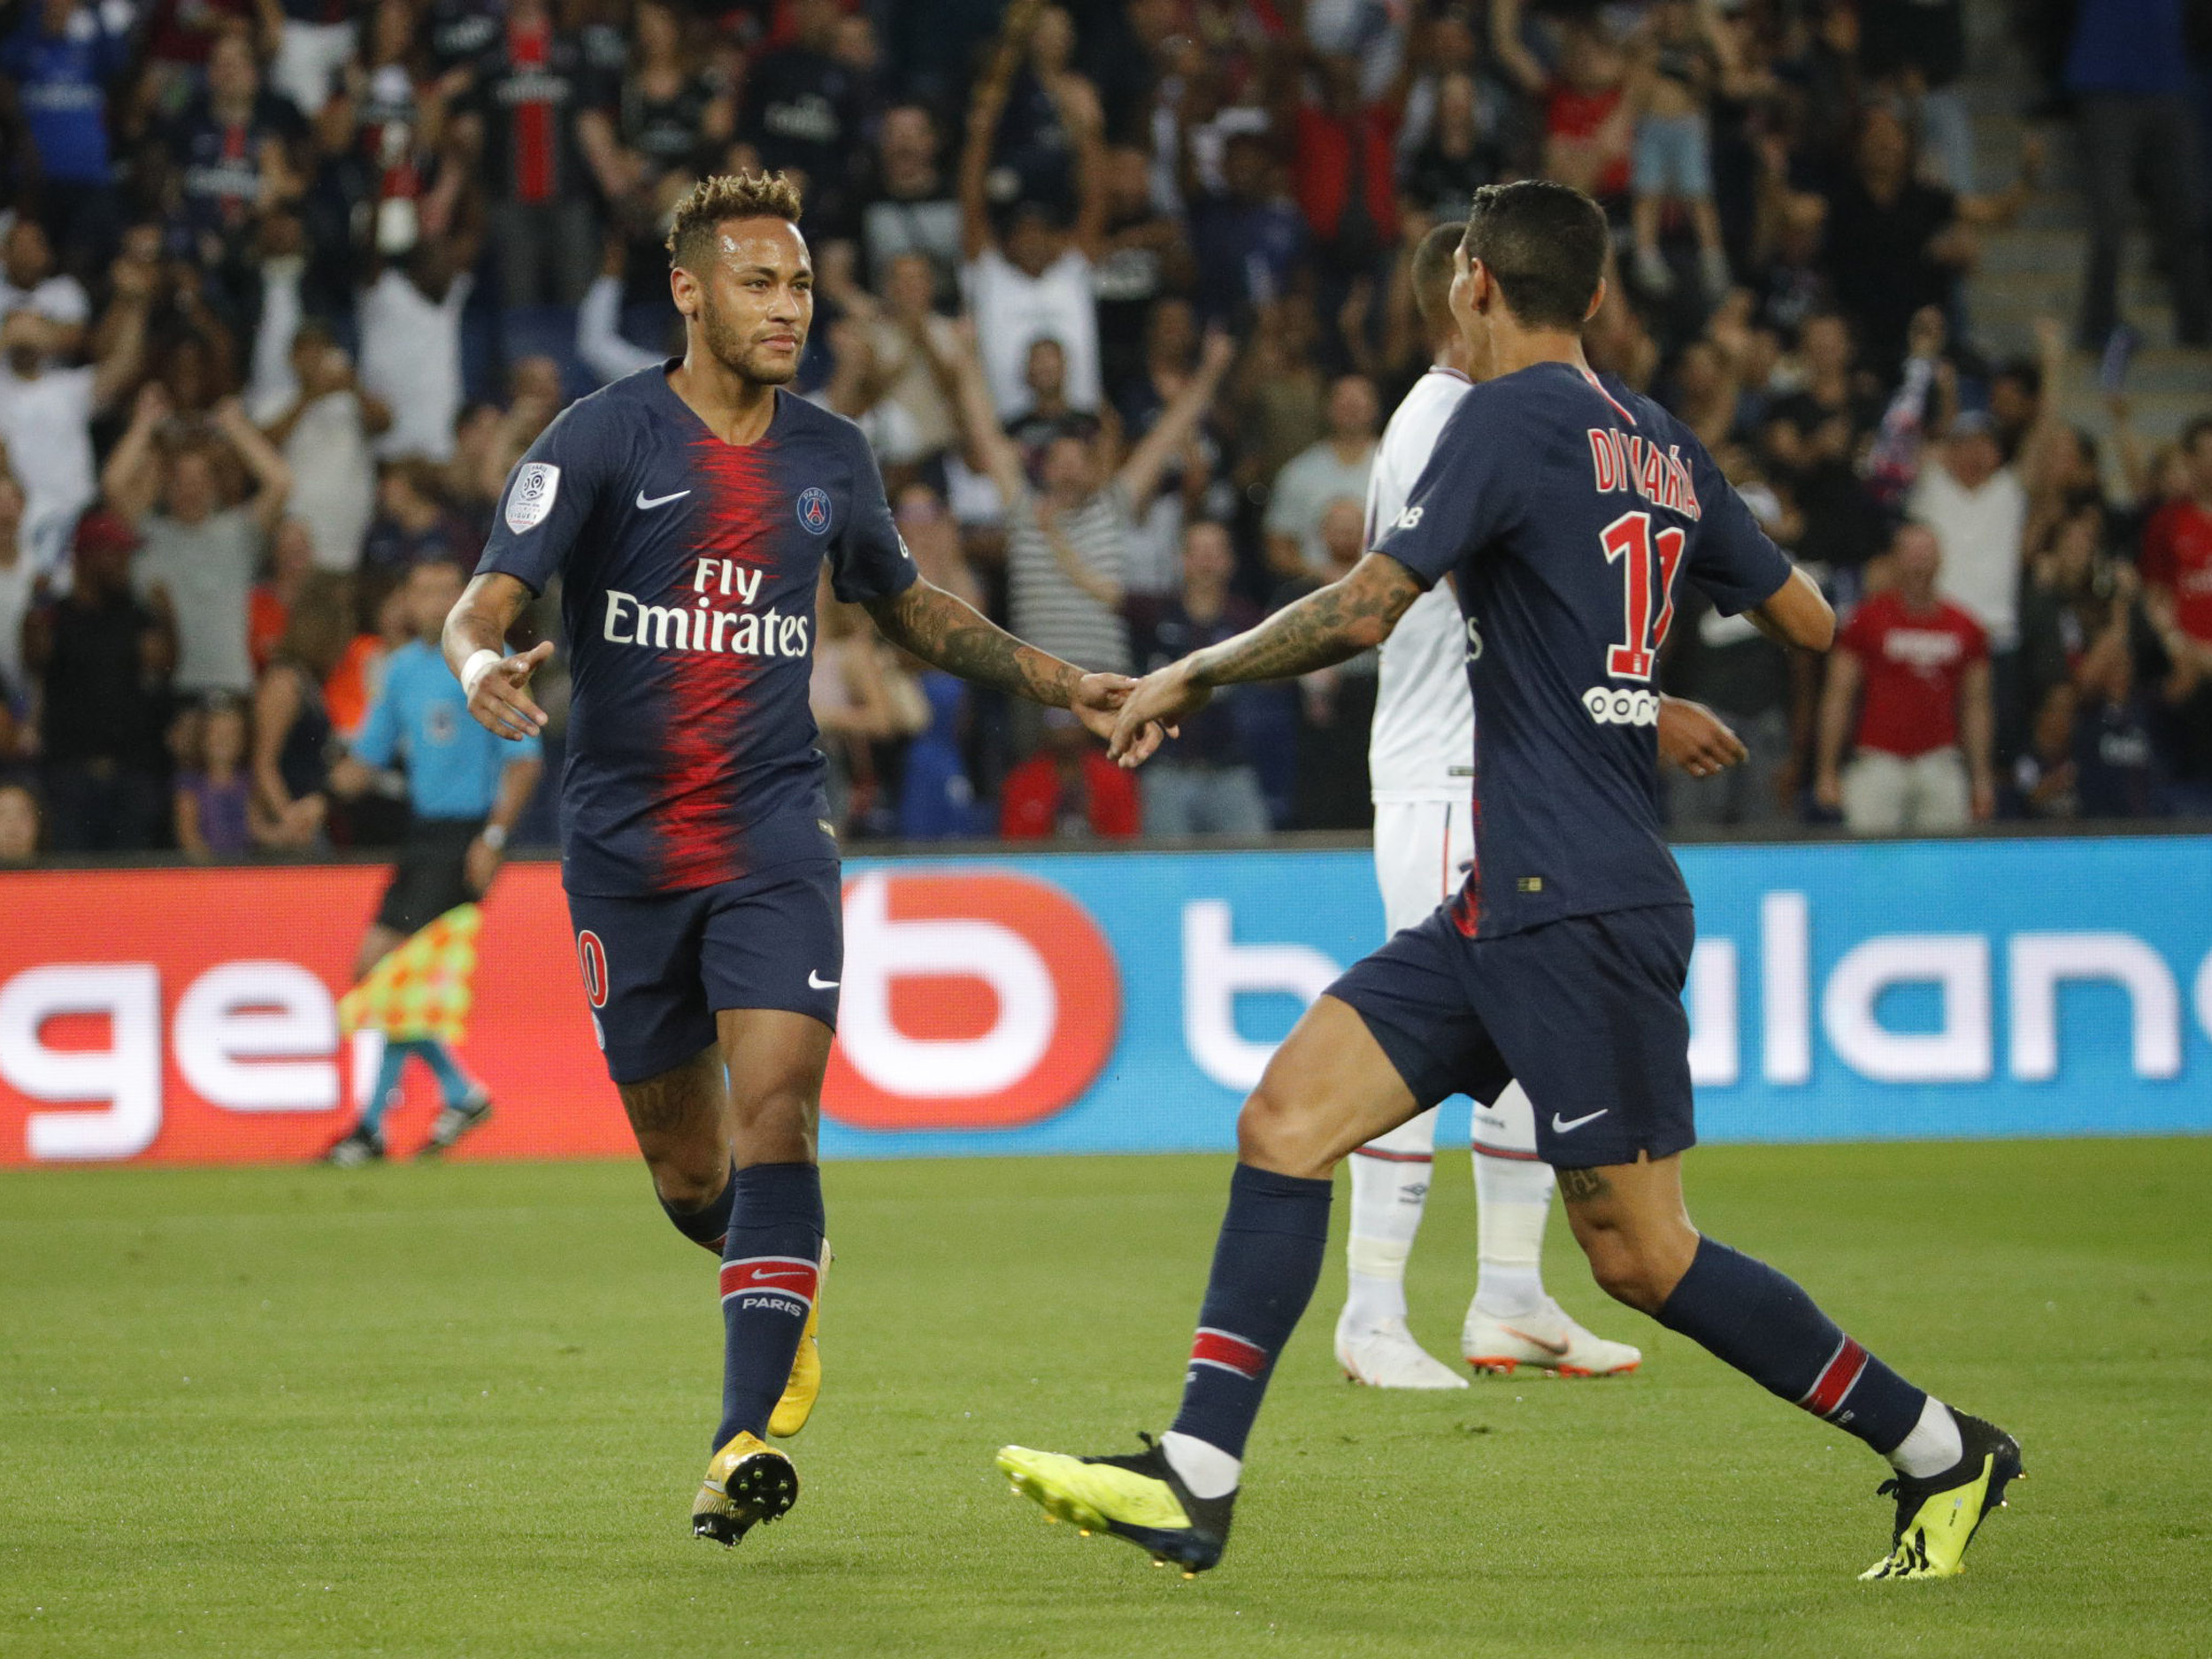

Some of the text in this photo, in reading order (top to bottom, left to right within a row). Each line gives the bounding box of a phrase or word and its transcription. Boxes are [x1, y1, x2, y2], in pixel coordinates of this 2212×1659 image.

[1586, 427, 1628, 493] DI
[803, 489, 827, 503] PARIS
[693, 557, 763, 605] Fly
[1599, 510, 1686, 682] 11
[603, 589, 808, 657] Emirates
[1586, 692, 1659, 721] oor
[741, 1296, 803, 1317] PARIS
